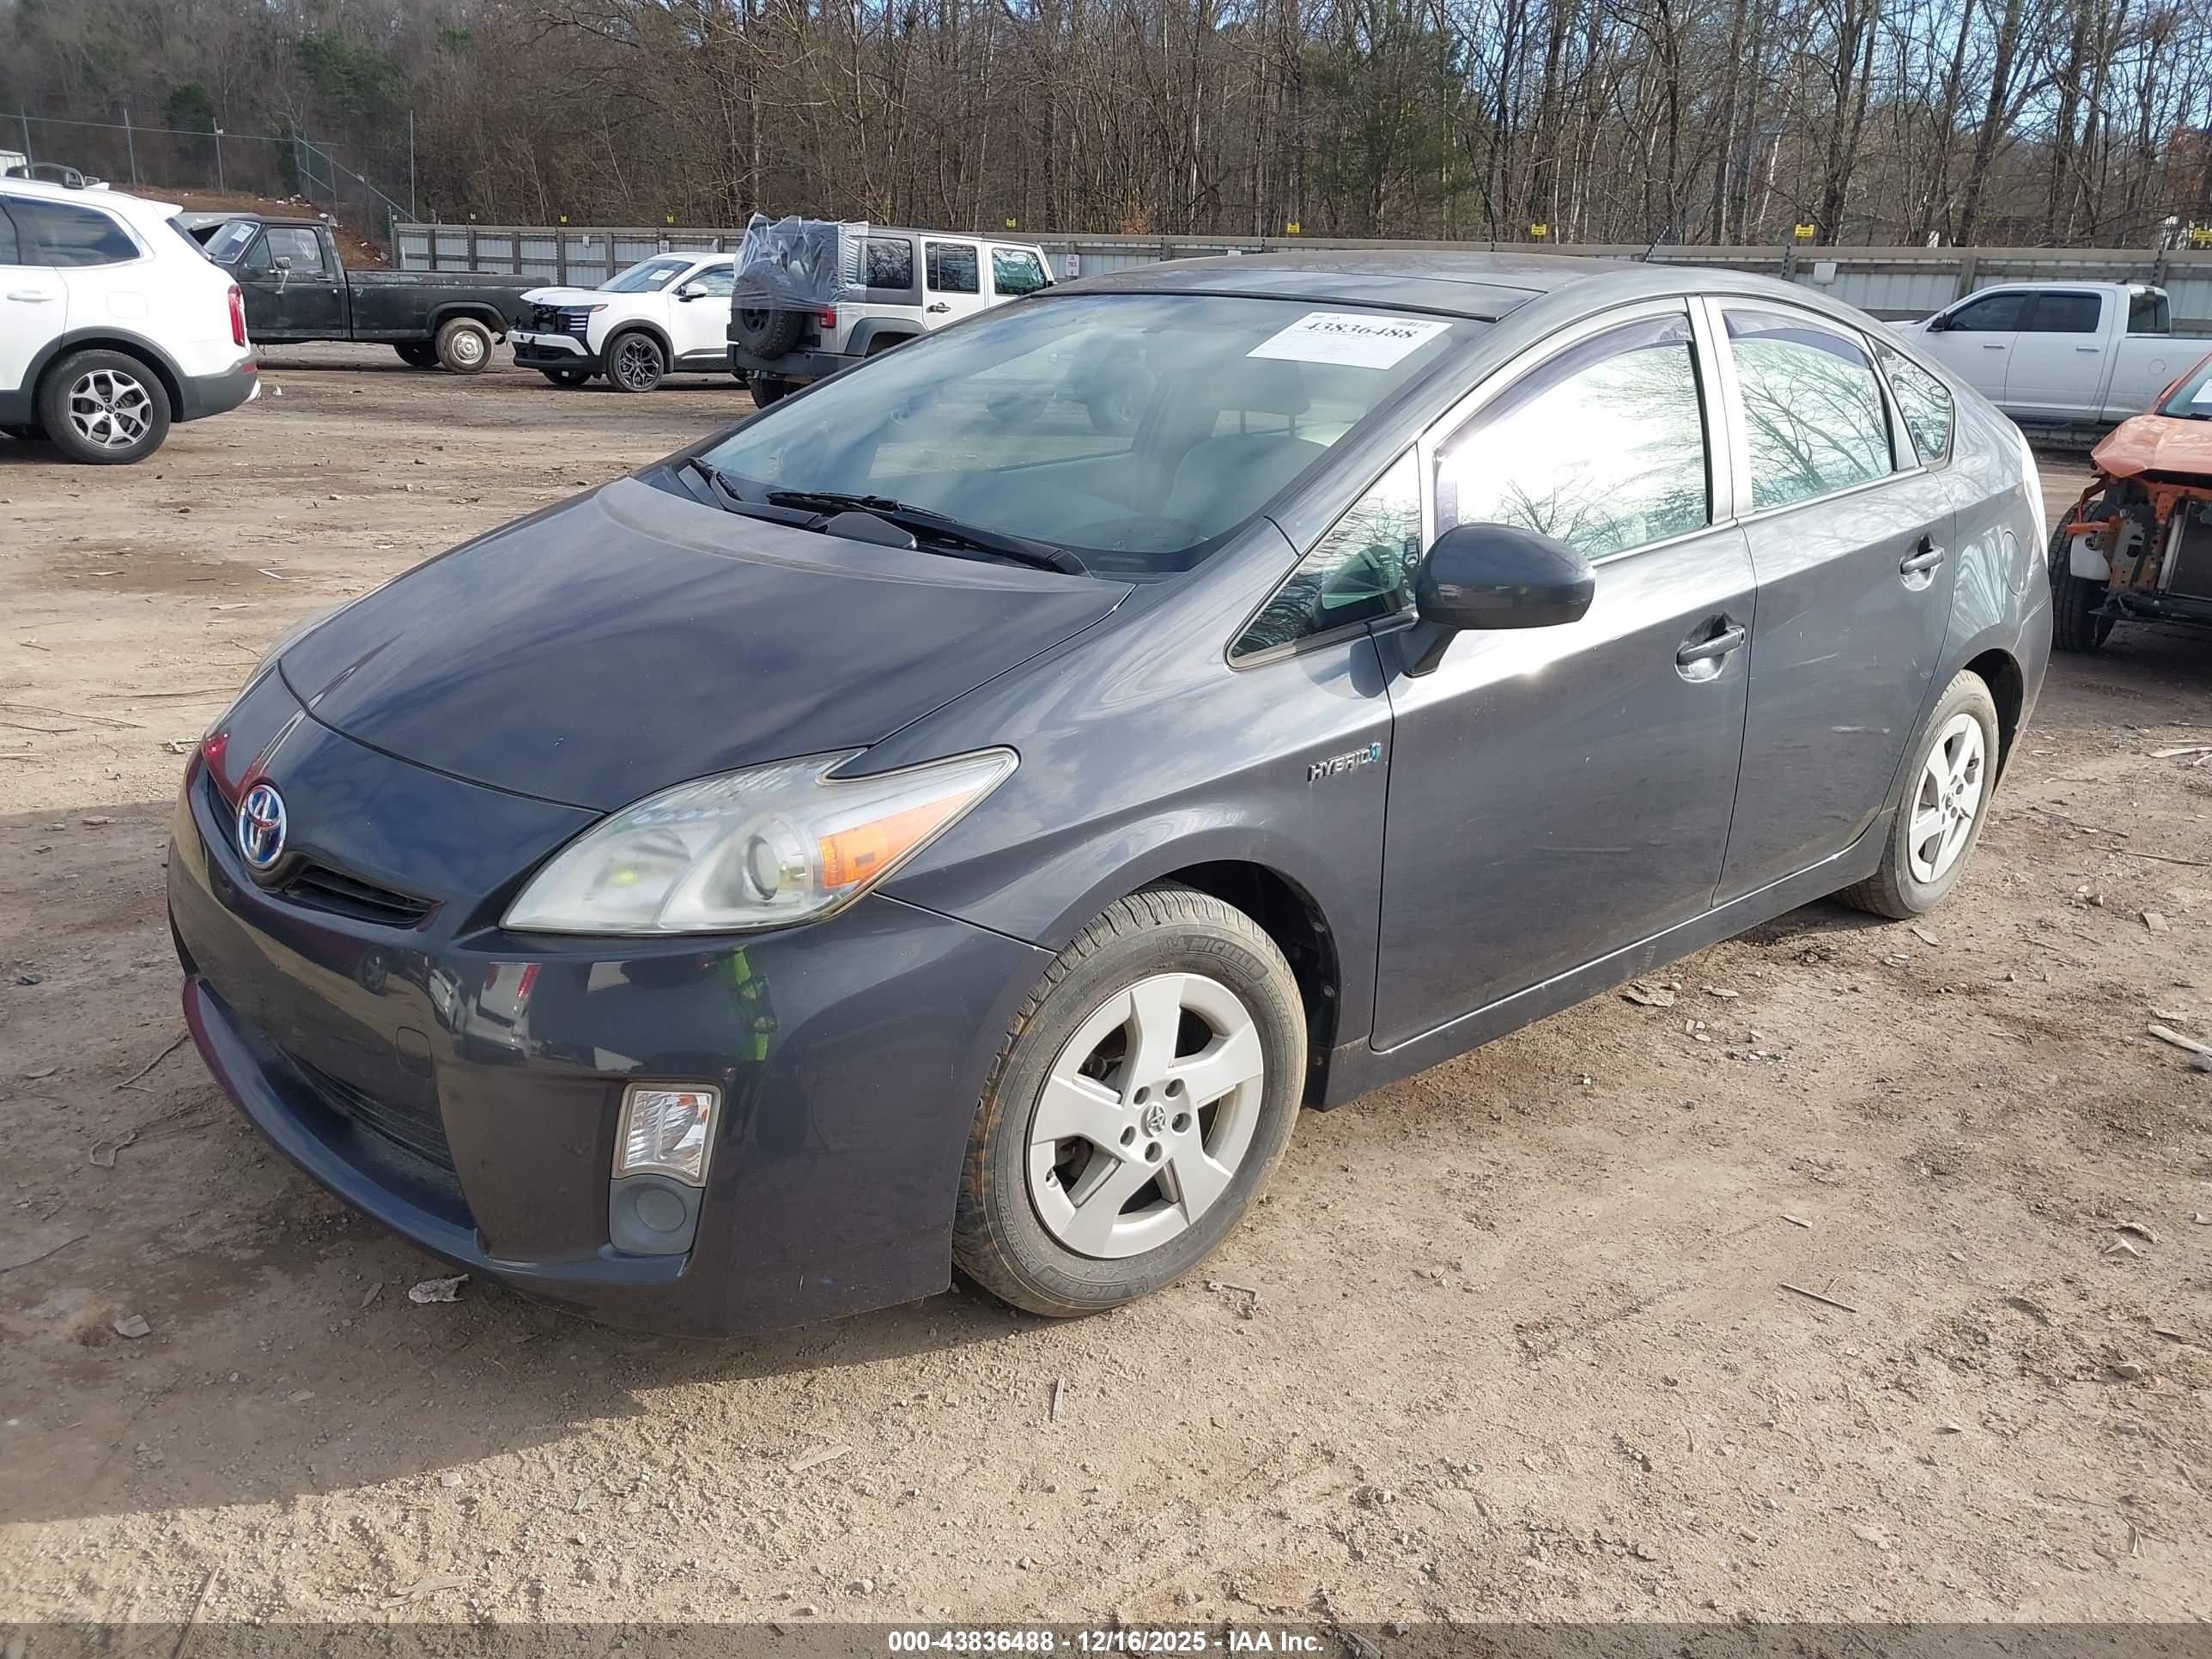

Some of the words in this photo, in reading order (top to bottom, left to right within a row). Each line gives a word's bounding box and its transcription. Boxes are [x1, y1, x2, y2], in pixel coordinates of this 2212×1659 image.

[1304, 321, 1419, 339] 43836488
[1306, 747, 1371, 783] HYBRID
[1188, 937, 1269, 981] MICHELIN
